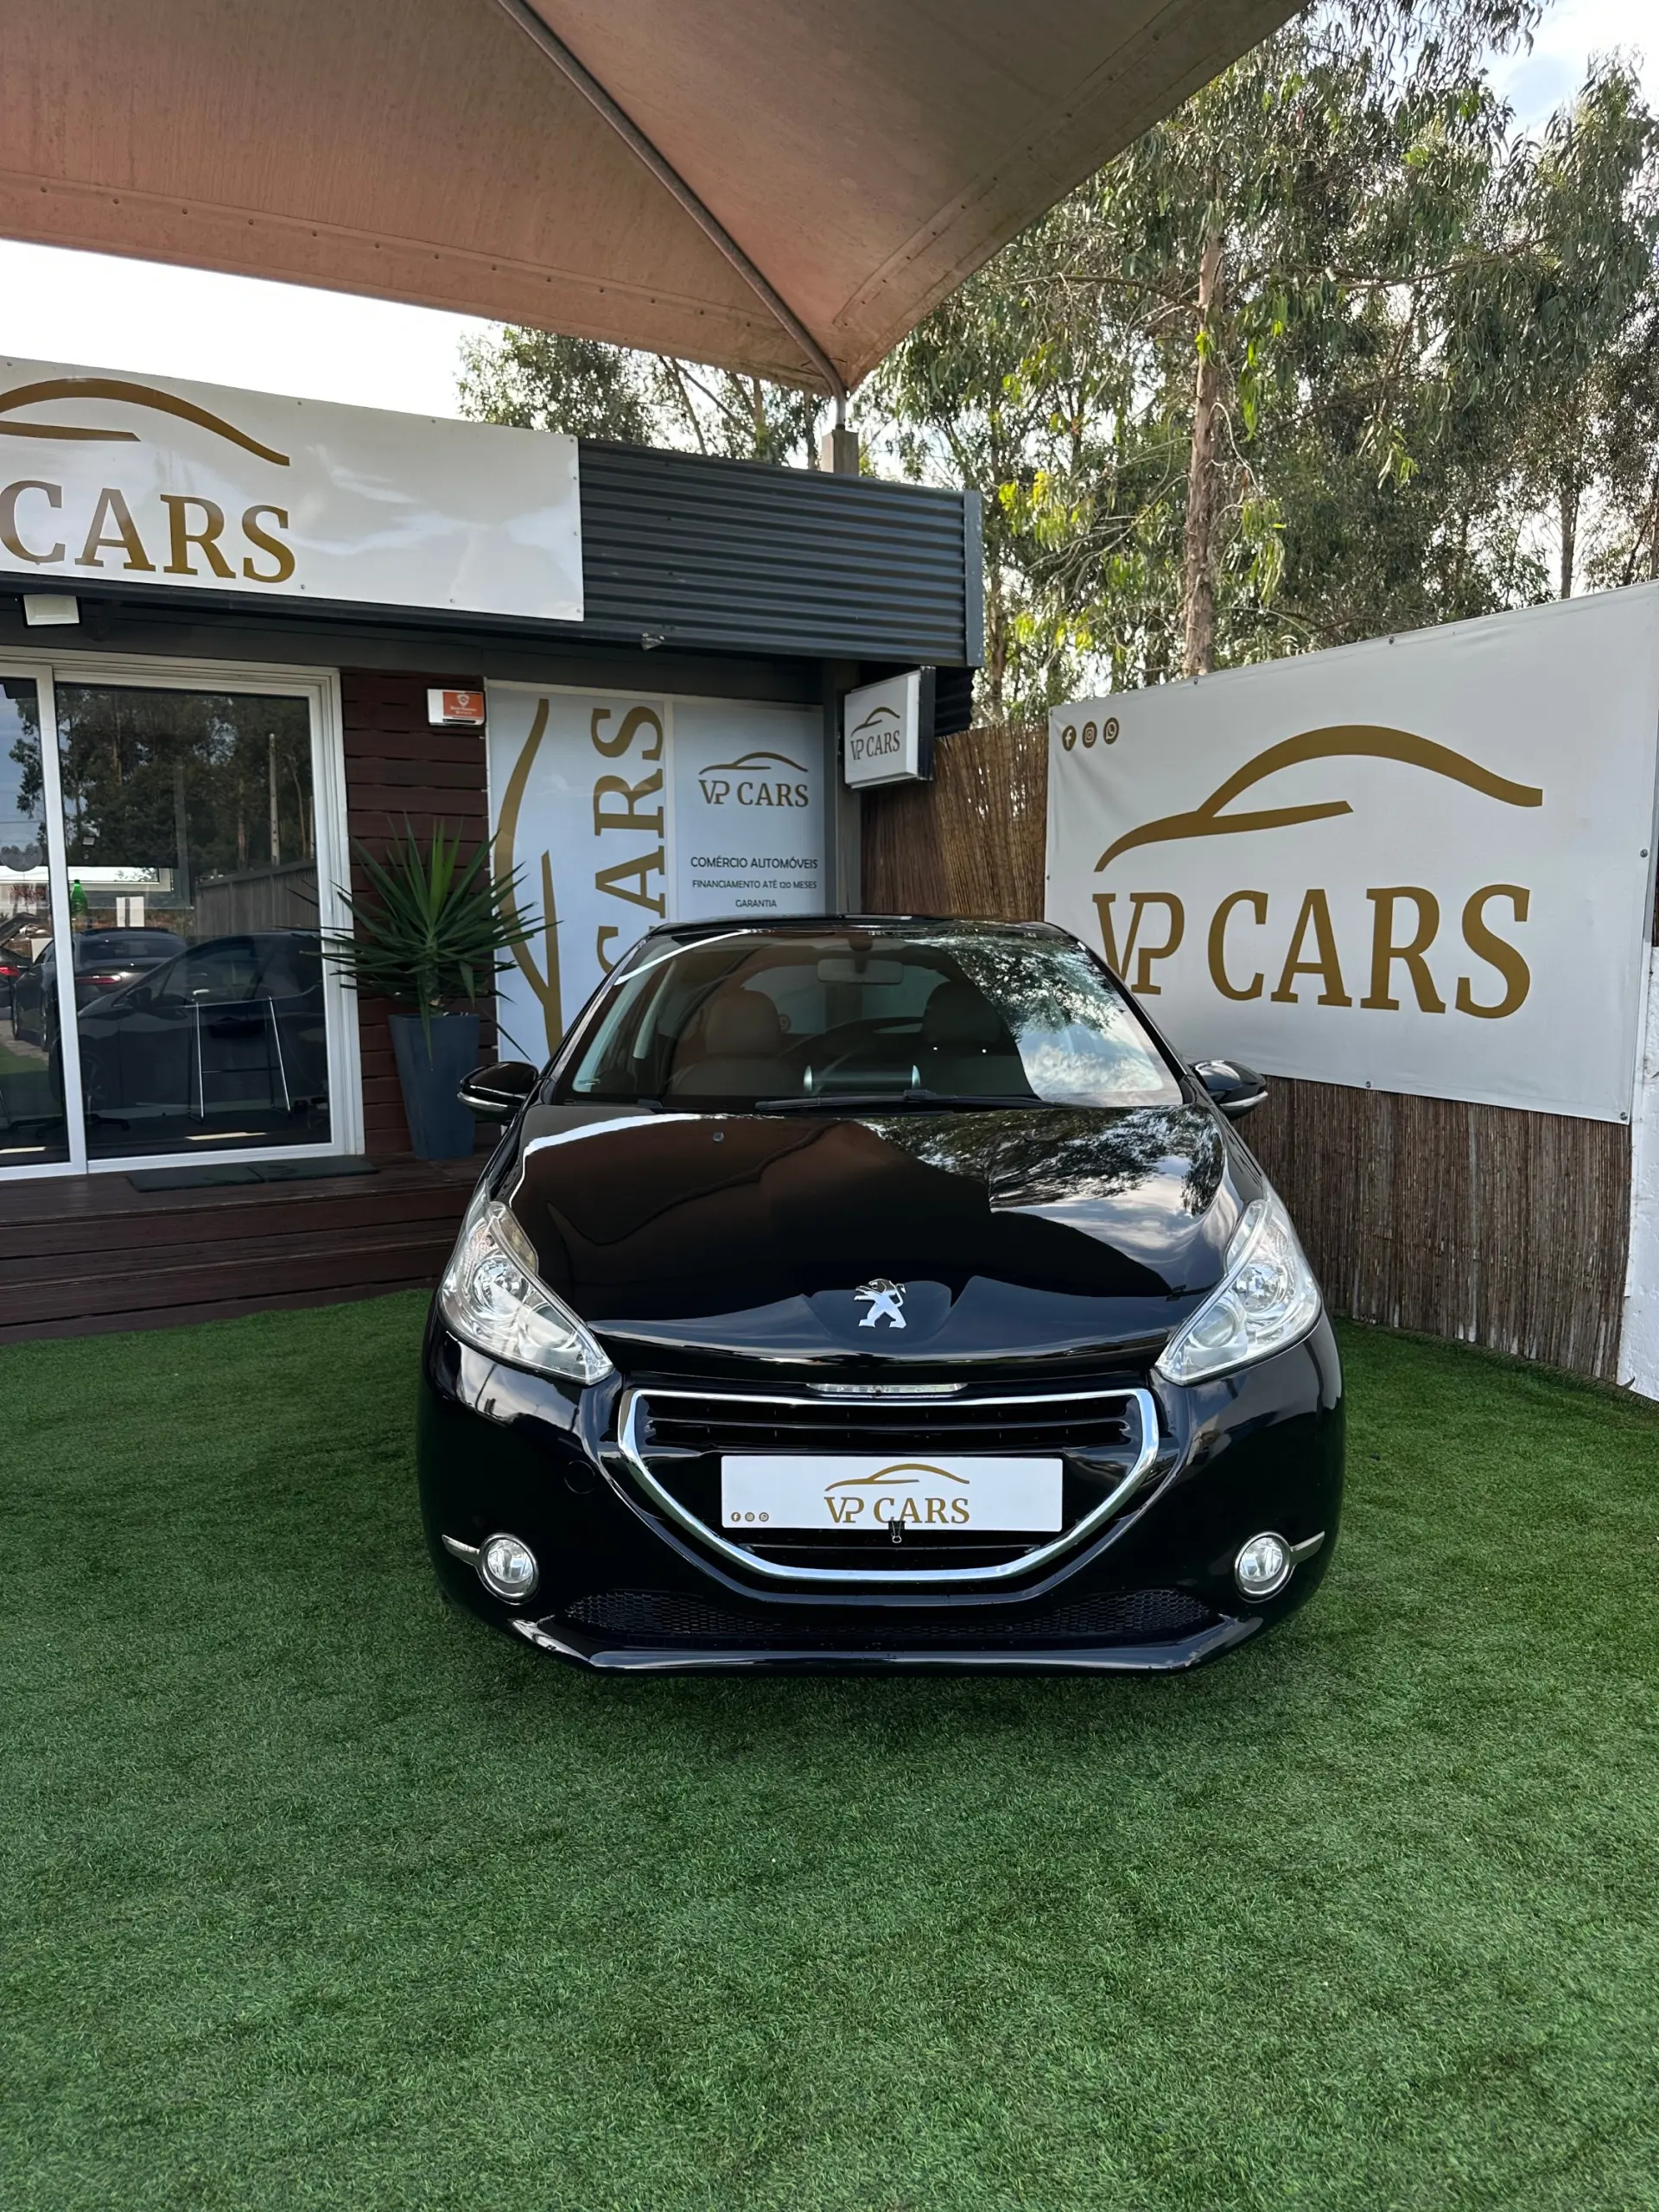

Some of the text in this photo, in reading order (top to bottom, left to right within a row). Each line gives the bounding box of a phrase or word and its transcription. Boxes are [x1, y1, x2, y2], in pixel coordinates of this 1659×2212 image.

[0, 480, 296, 583] CARS
[850, 730, 900, 760] VP CARS
[698, 779, 809, 808] VP CARS
[690, 855, 819, 869] COMÉRCIO AUTOMÓVEIS
[692, 880, 761, 889] FINANCIAMENTO
[762, 880, 778, 889] ATÉ
[735, 899, 778, 908] GARANTIA
[1092, 884, 1531, 1019] VP CARS
[823, 1496, 969, 1524] VP CARS
